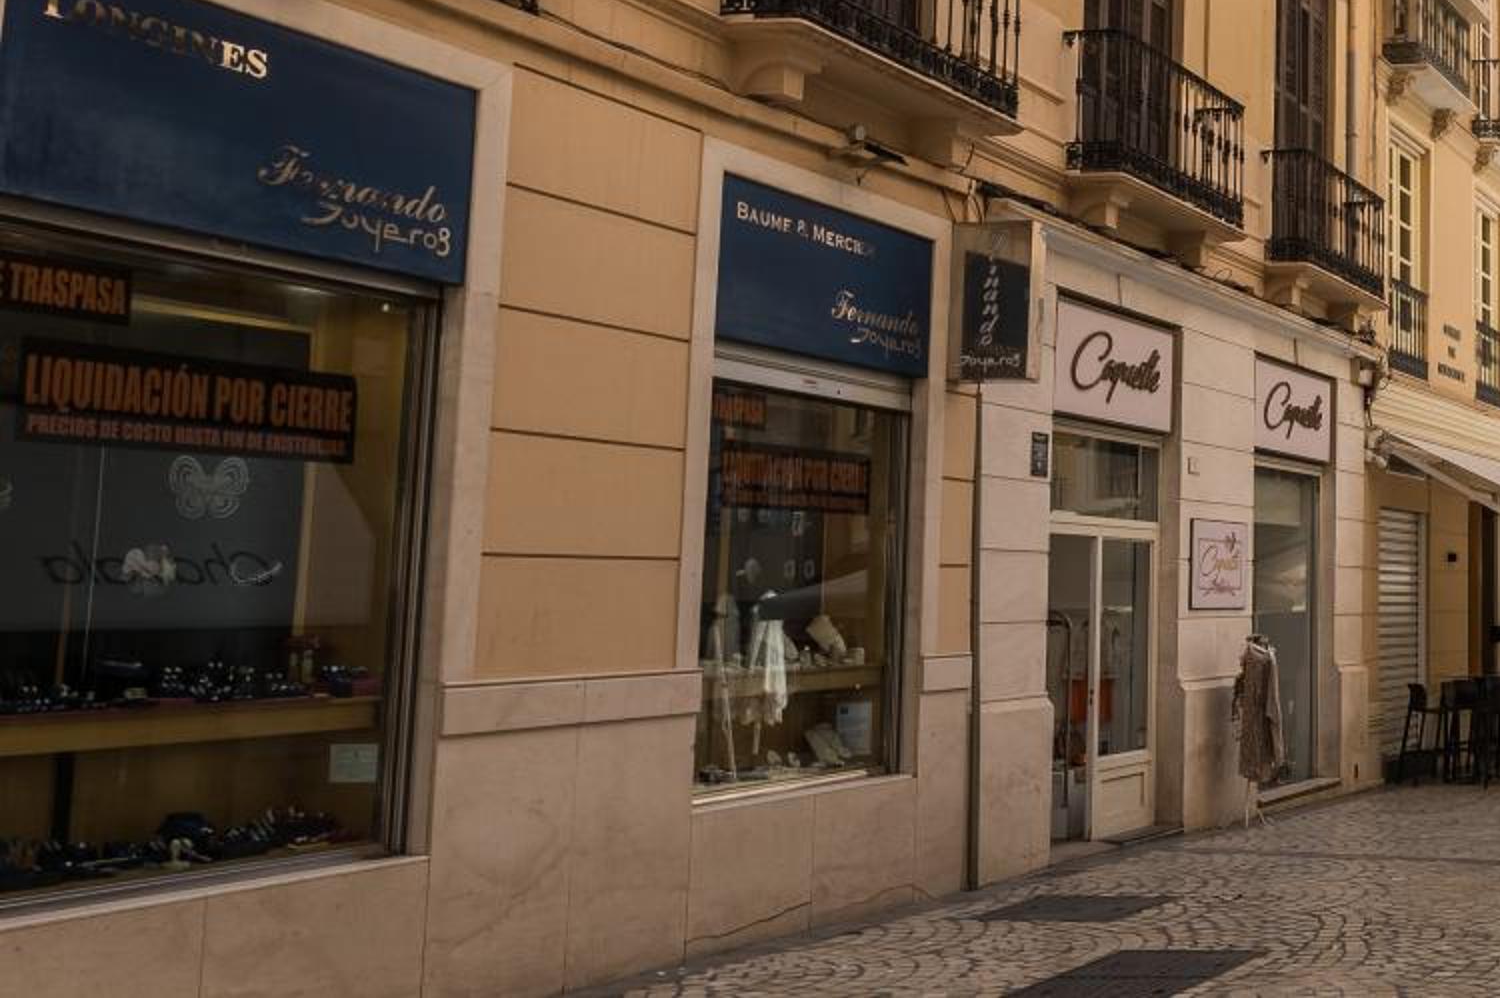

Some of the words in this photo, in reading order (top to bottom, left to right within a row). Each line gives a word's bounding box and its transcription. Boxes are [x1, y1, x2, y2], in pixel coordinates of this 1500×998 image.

[258, 145, 448, 225] Fernando
[737, 201, 794, 233] BAUME
[797, 218, 809, 238] &
[9, 263, 126, 316] TRASPASA
[831, 289, 919, 335] Fernando
[25, 353, 209, 419] LIQUIDACIÓN
[215, 375, 265, 424] POR
[271, 379, 353, 433] CIERRE
[1070, 330, 1162, 405] Coquette
[27, 416, 97, 439] PRECIOS
[99, 419, 121, 441] DE
[123, 421, 172, 443] COSTO
[1263, 381, 1323, 440] Coquette
